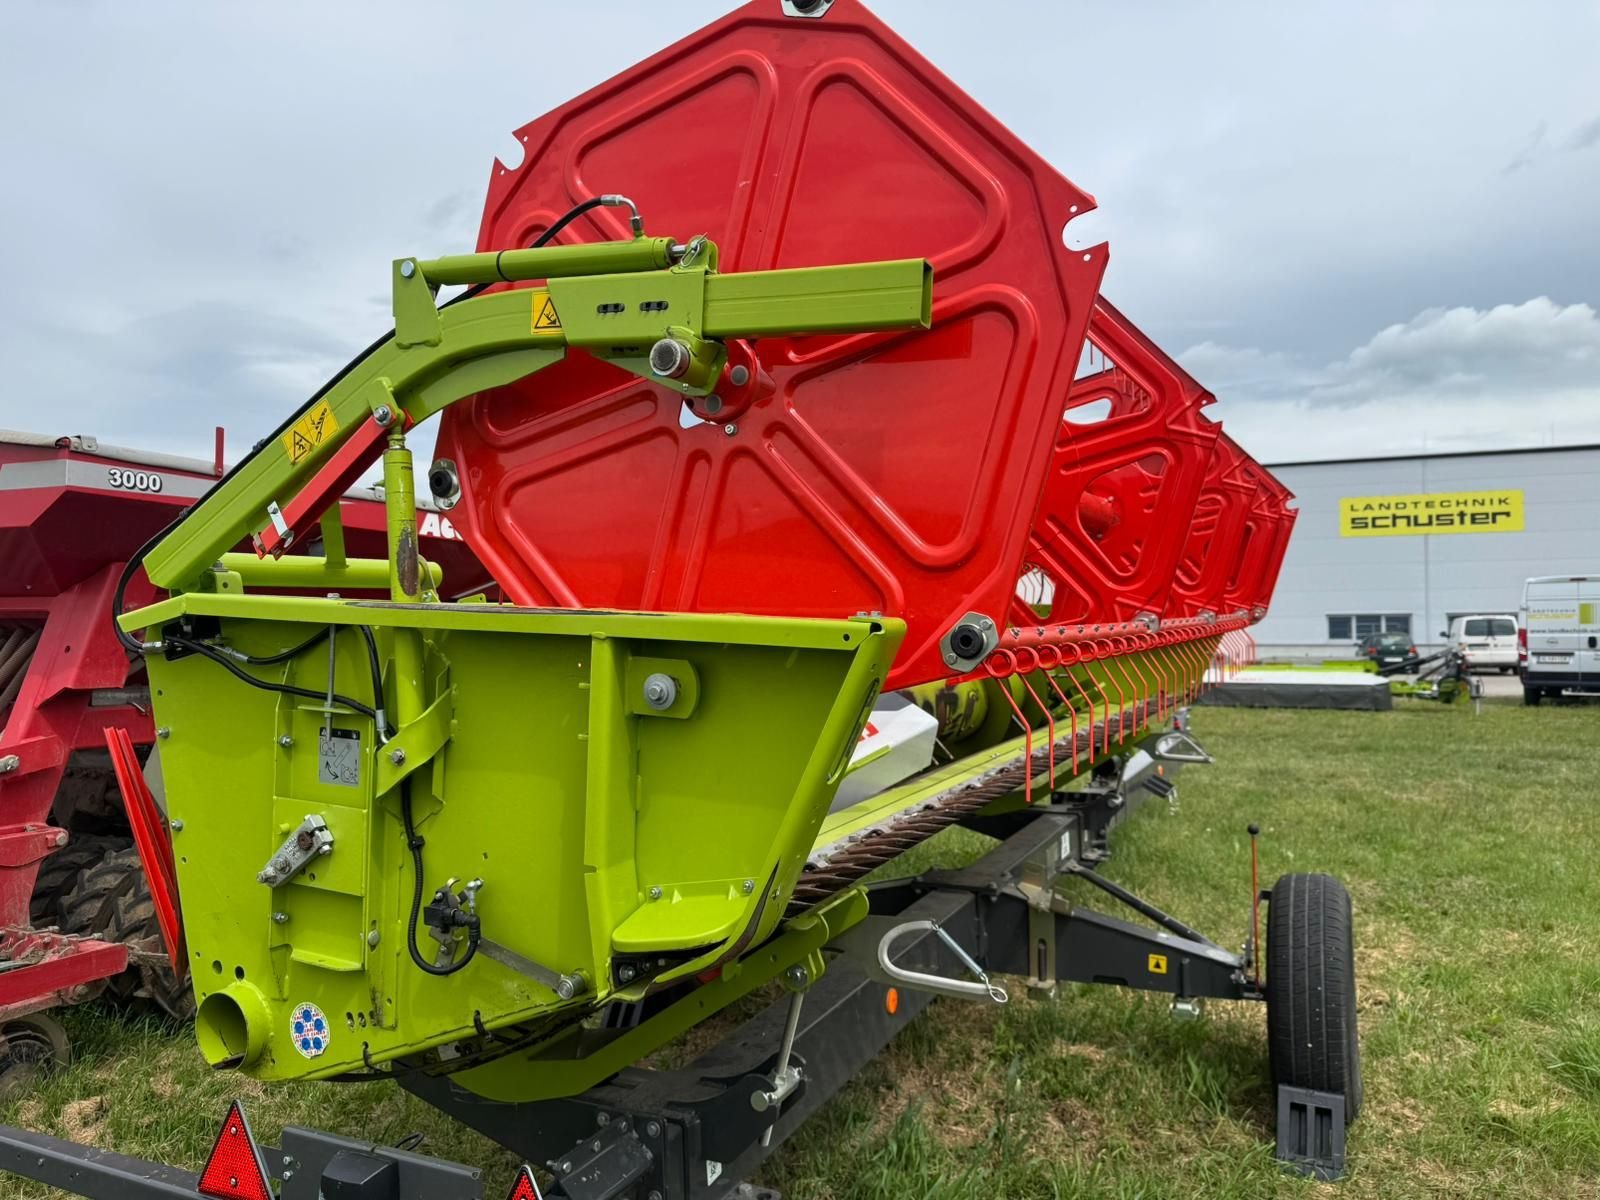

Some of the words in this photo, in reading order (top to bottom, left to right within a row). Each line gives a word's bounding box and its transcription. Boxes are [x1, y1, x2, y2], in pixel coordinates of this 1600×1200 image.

[108, 468, 162, 493] 3000
[1350, 497, 1510, 512] LANDTECHNIK
[1350, 510, 1511, 529] schuster
